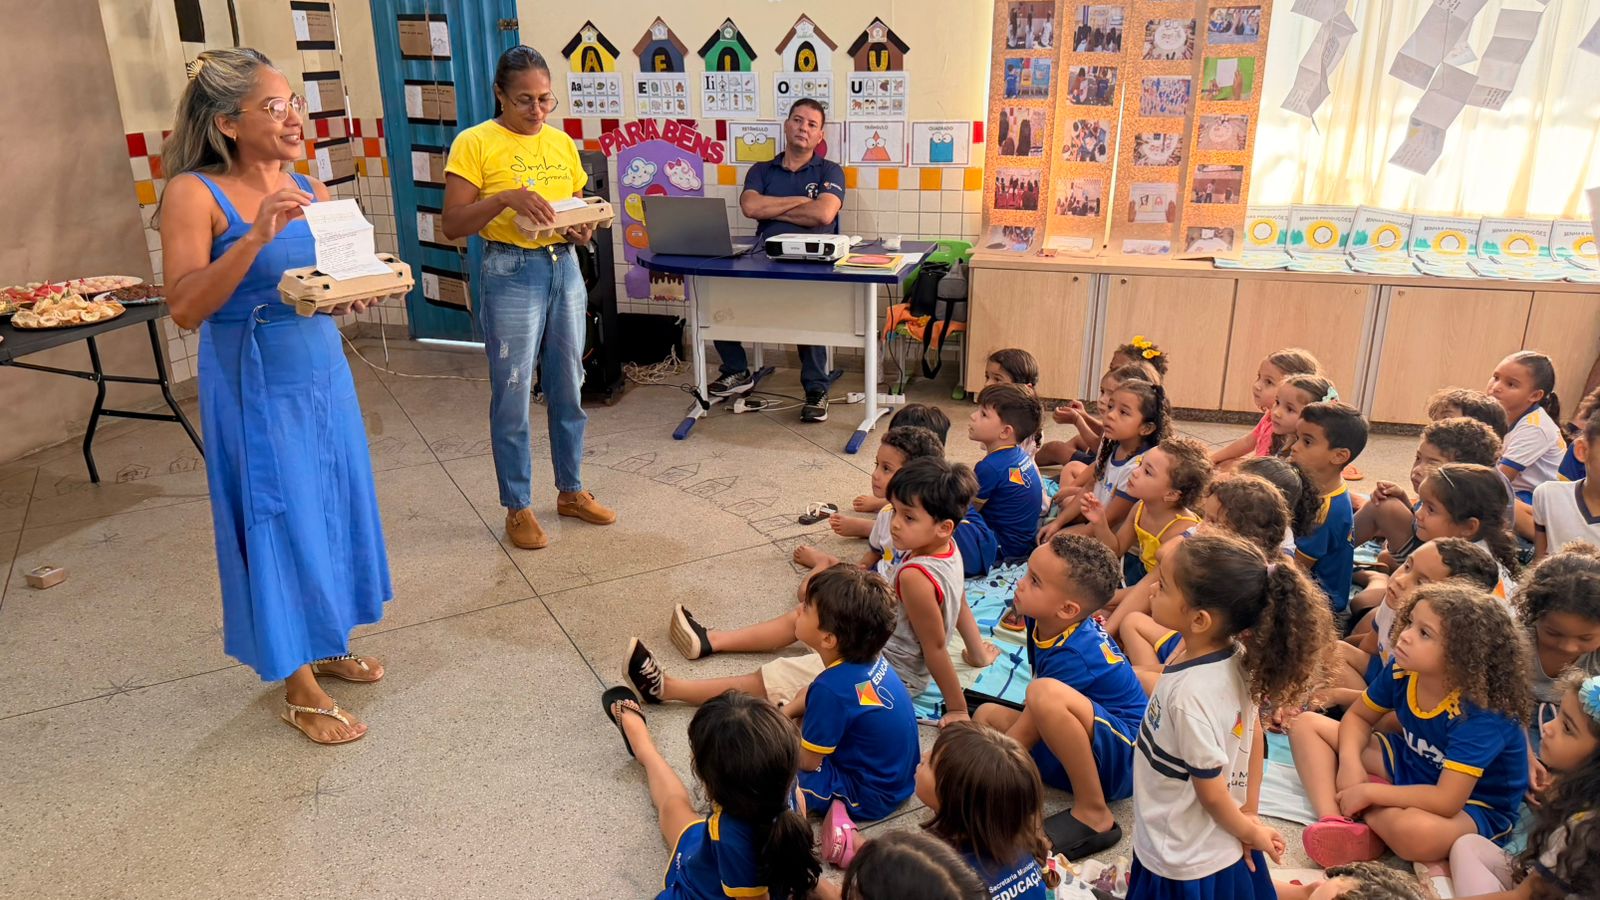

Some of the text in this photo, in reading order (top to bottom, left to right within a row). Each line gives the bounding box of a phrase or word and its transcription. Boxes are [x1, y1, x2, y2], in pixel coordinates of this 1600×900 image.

[584, 51, 604, 72] A
[655, 55, 668, 72] E
[724, 54, 731, 72] I
[798, 48, 816, 72] O
[869, 50, 889, 72] U
[571, 81, 582, 92] Aa
[638, 82, 647, 94] E
[705, 75, 716, 90] Ii
[777, 81, 790, 94] O
[851, 81, 863, 94] U
[598, 117, 726, 165] PARABÉNS
[988, 872, 1018, 894] Secretaria
